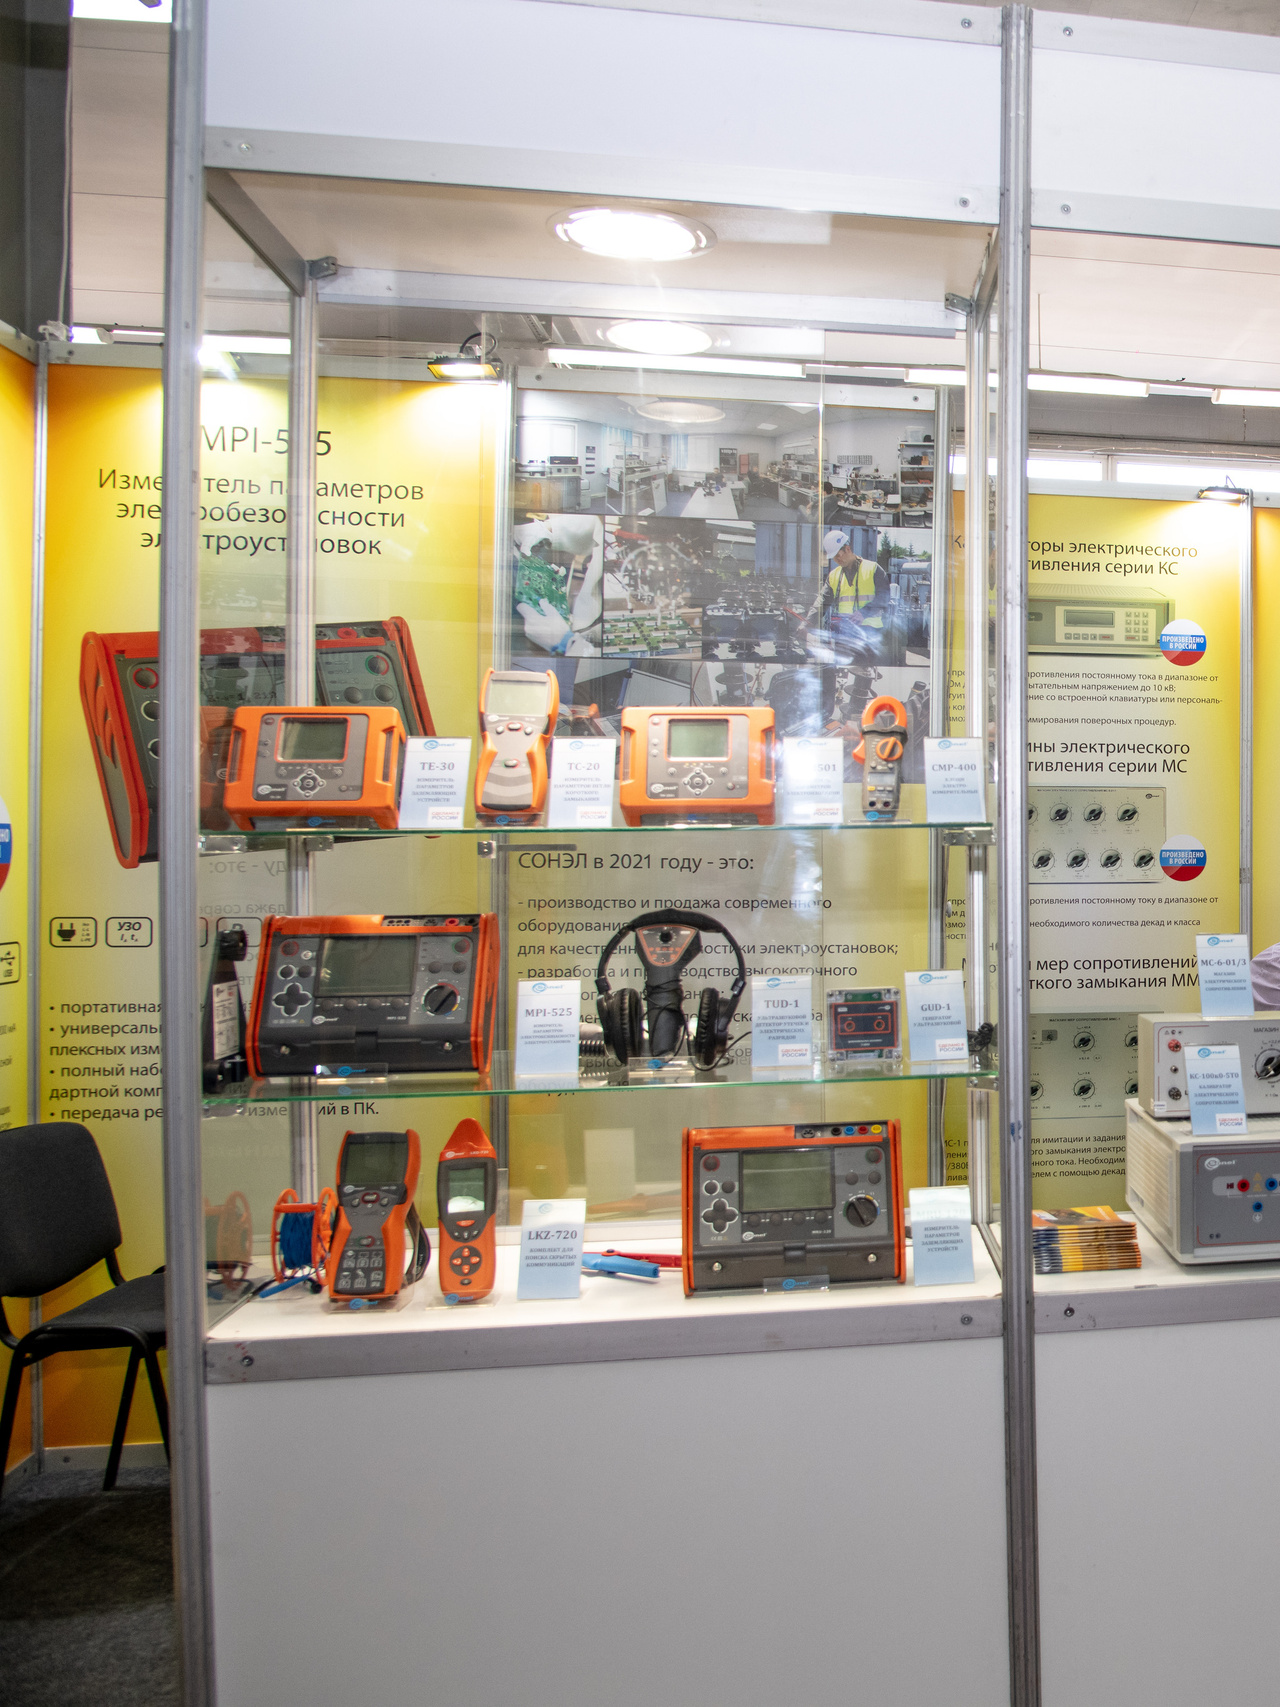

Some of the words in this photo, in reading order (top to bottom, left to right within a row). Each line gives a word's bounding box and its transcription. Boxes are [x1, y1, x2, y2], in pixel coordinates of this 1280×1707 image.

[201, 425, 332, 456] MPI-55
[99, 468, 261, 494] Изметель
[270, 480, 424, 505] паметров
[116, 501, 405, 528] элеобезосности
[1068, 541, 1198, 559] электрического
[1105, 562, 1154, 577] серии
[1159, 561, 1179, 576] КС
[1162, 635, 1205, 644] ПРОИЗВЕДЕНО
[1081, 672, 1137, 683] постоянному
[1164, 675, 1208, 684] диапазоне
[1081, 683, 1139, 692] напряжением
[1140, 685, 1151, 693] до
[1153, 684, 1163, 692] 10
[1058, 693, 1107, 703] встроенной
[1109, 695, 1158, 704] клавиатуры
[1080, 716, 1132, 726] поверочных
[1060, 742, 1190, 757] электрического
[1108, 761, 1157, 776] серии
[1162, 759, 1187, 773] МС
[1161, 851, 1204, 859] ПРОИЗВЕДЕНО
[518, 852, 588, 869] СОНЭЛ
[594, 857, 604, 869] в
[609, 853, 651, 869] 2021
[660, 857, 702, 874] году
[718, 857, 754, 870] это:
[527, 898, 637, 911] производство
[641, 899, 650, 909] и
[654, 899, 721, 911] продажа
[724, 899, 832, 912] современного
[1081, 897, 1136, 906] постоянному
[1137, 897, 1156, 905] току
[1164, 897, 1208, 905] диапазоне
[117, 921, 142, 931] УЗО
[1029, 918, 1090, 928] необходимого
[1092, 919, 1139, 927] количества
[1140, 919, 1165, 928] декад
[1173, 918, 1201, 926] класса
[518, 944, 546, 957] для
[1036, 960, 1069, 973] мер
[1029, 978, 1072, 989] ткого
[1077, 976, 1167, 989] замыкания
[1171, 973, 1200, 987] ММ
[60, 1023, 163, 1038] универсаль
[50, 1044, 126, 1056] плексных
[61, 1063, 125, 1077] полный
[50, 1085, 119, 1101] дартной
[61, 1109, 140, 1122] передача
[341, 1105, 349, 1115] в
[1042, 1136, 1084, 1144] имитации
[1092, 1135, 1126, 1143] задания
[1045, 1147, 1091, 1155] замыкания
[1059, 1169, 1100, 1177] помощью
